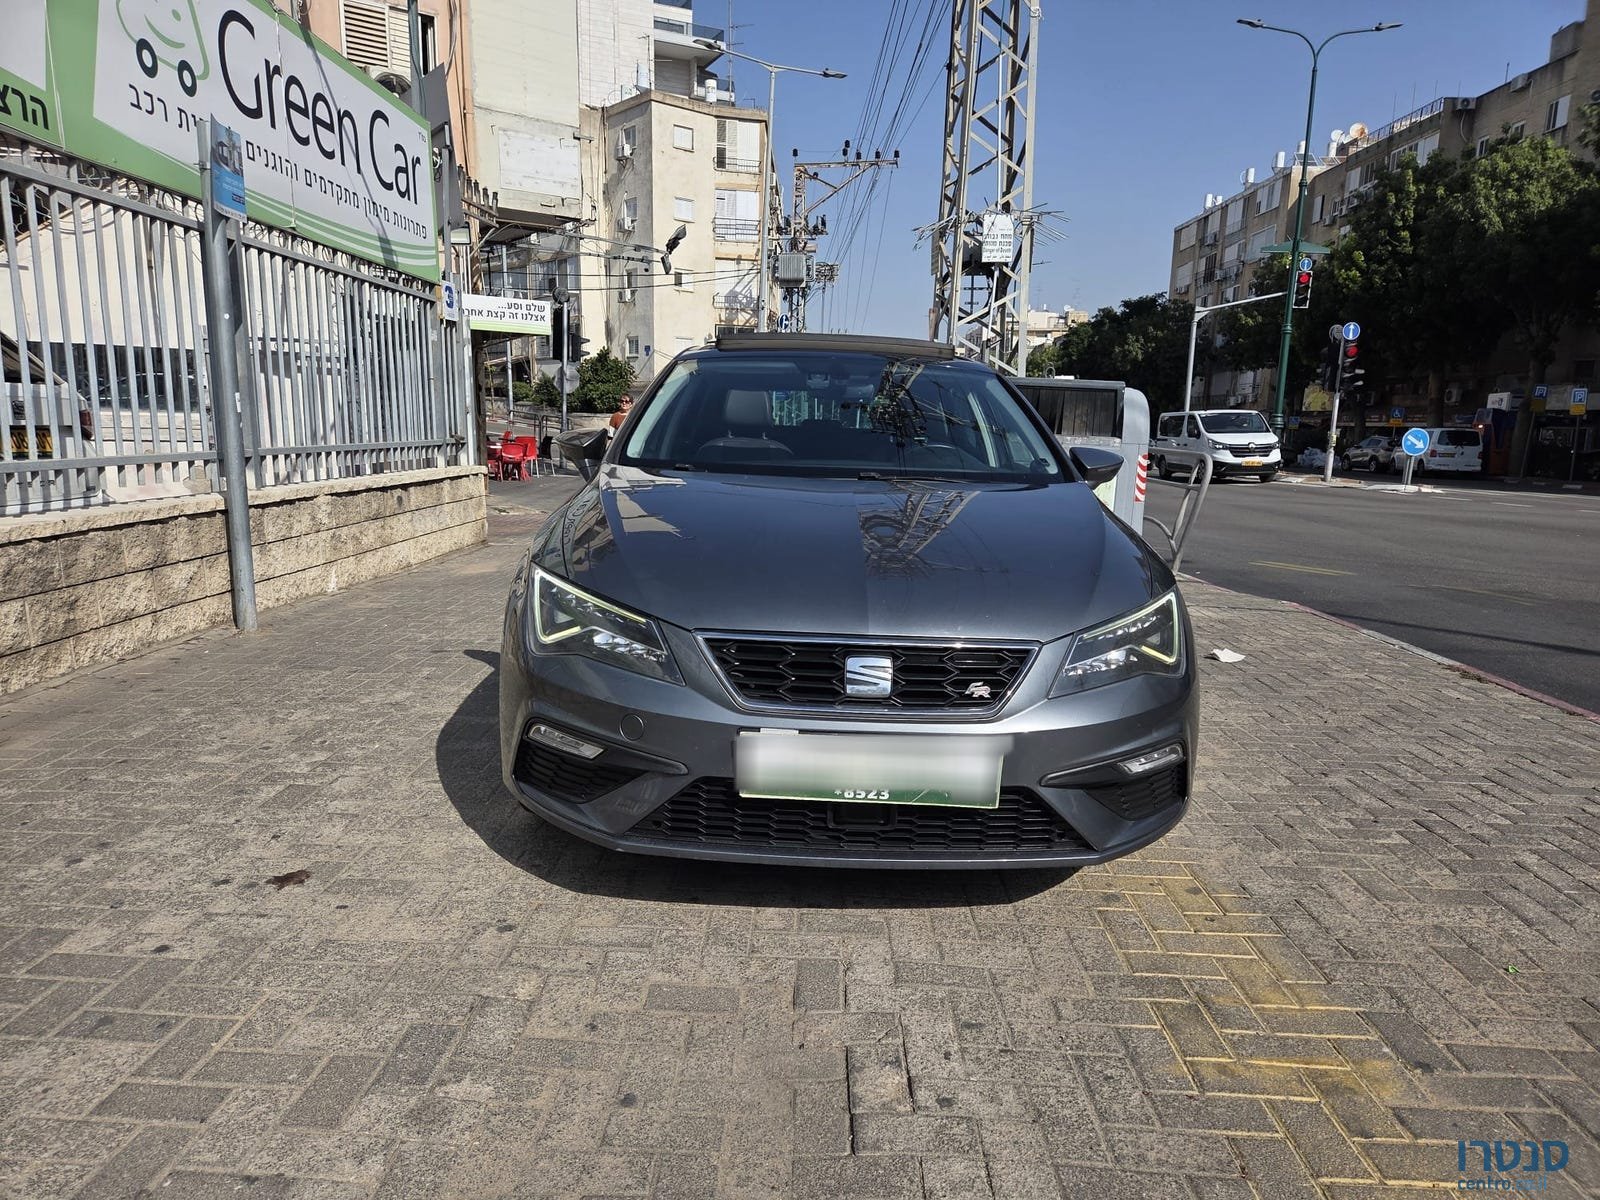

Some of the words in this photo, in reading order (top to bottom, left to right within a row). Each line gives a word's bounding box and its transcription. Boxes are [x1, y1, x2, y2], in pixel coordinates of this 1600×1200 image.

[129, 83, 168, 122] רכב
[218, 9, 361, 174] Green
[369, 109, 421, 205] Car
[245, 140, 299, 181] והוגנים
[304, 168, 360, 209] מתקדמים
[363, 196, 390, 223] מימון
[392, 211, 427, 239] פתרונות
[486, 310, 506, 320] קצת
[498, 302, 523, 310] וסע...
[508, 312, 518, 320] זה
[521, 312, 546, 322] אצלנו
[525, 302, 546, 312] שלם
